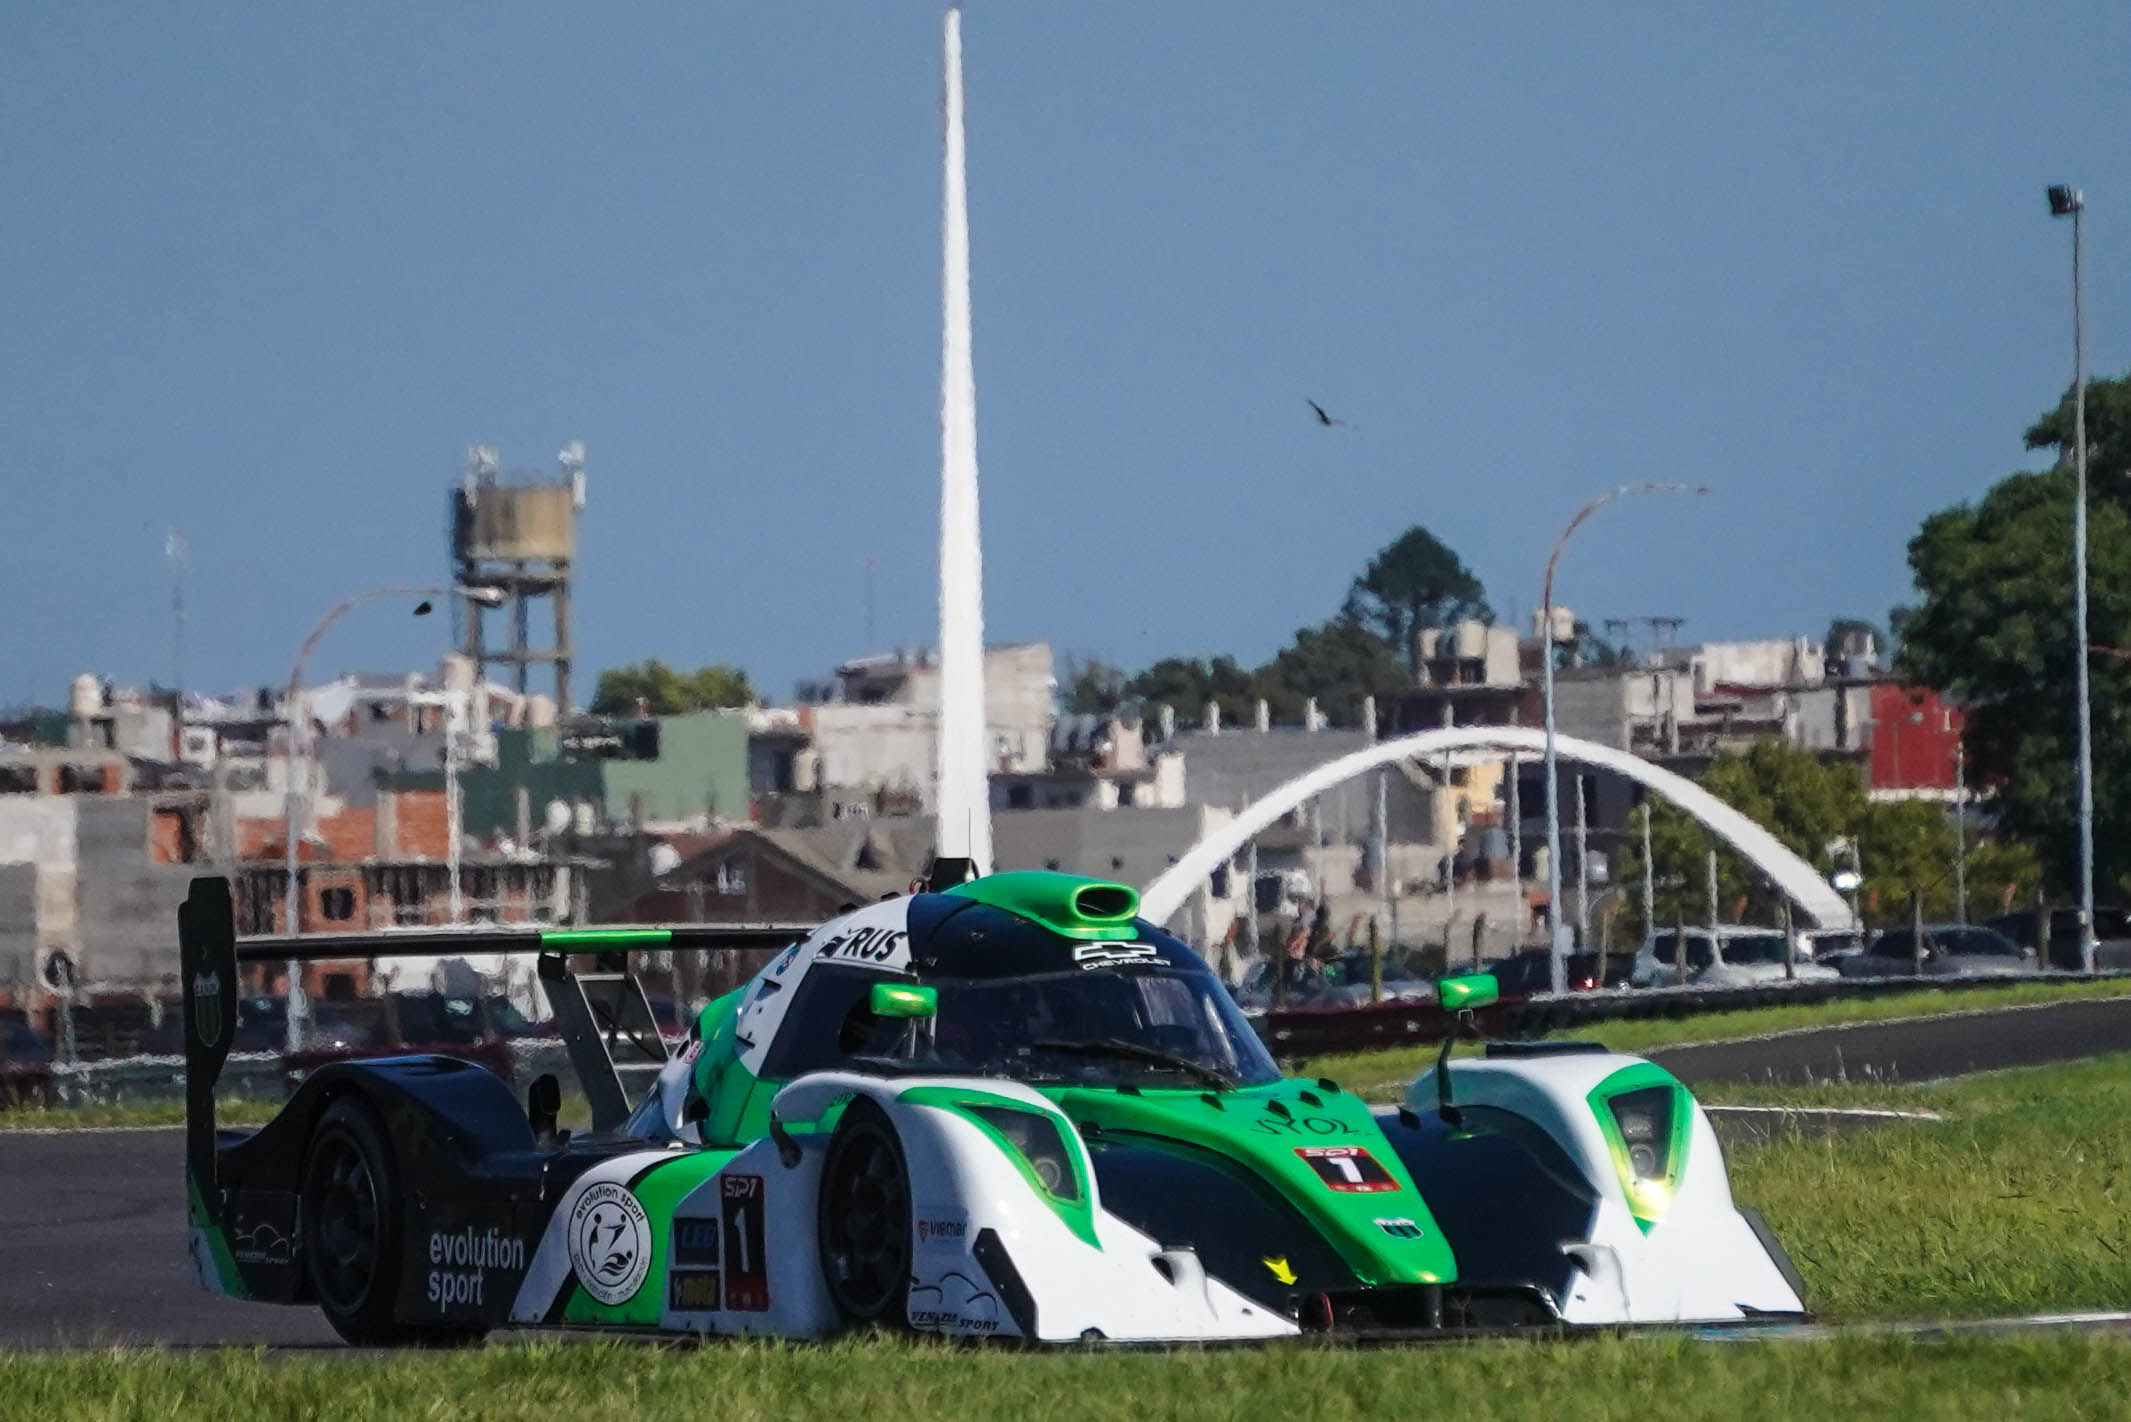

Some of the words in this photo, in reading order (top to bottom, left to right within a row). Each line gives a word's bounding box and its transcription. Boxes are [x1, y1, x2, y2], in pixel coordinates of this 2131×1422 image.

[1082, 957, 1171, 971] CHEVROLET
[1327, 1156, 1365, 1184] 1
[575, 1184, 619, 1220] evolution
[619, 1192, 646, 1223] sport
[429, 1225, 525, 1271] evolution
[734, 1207, 750, 1274] 1
[427, 1266, 485, 1313] sport
[959, 1318, 1000, 1332] SPORT
